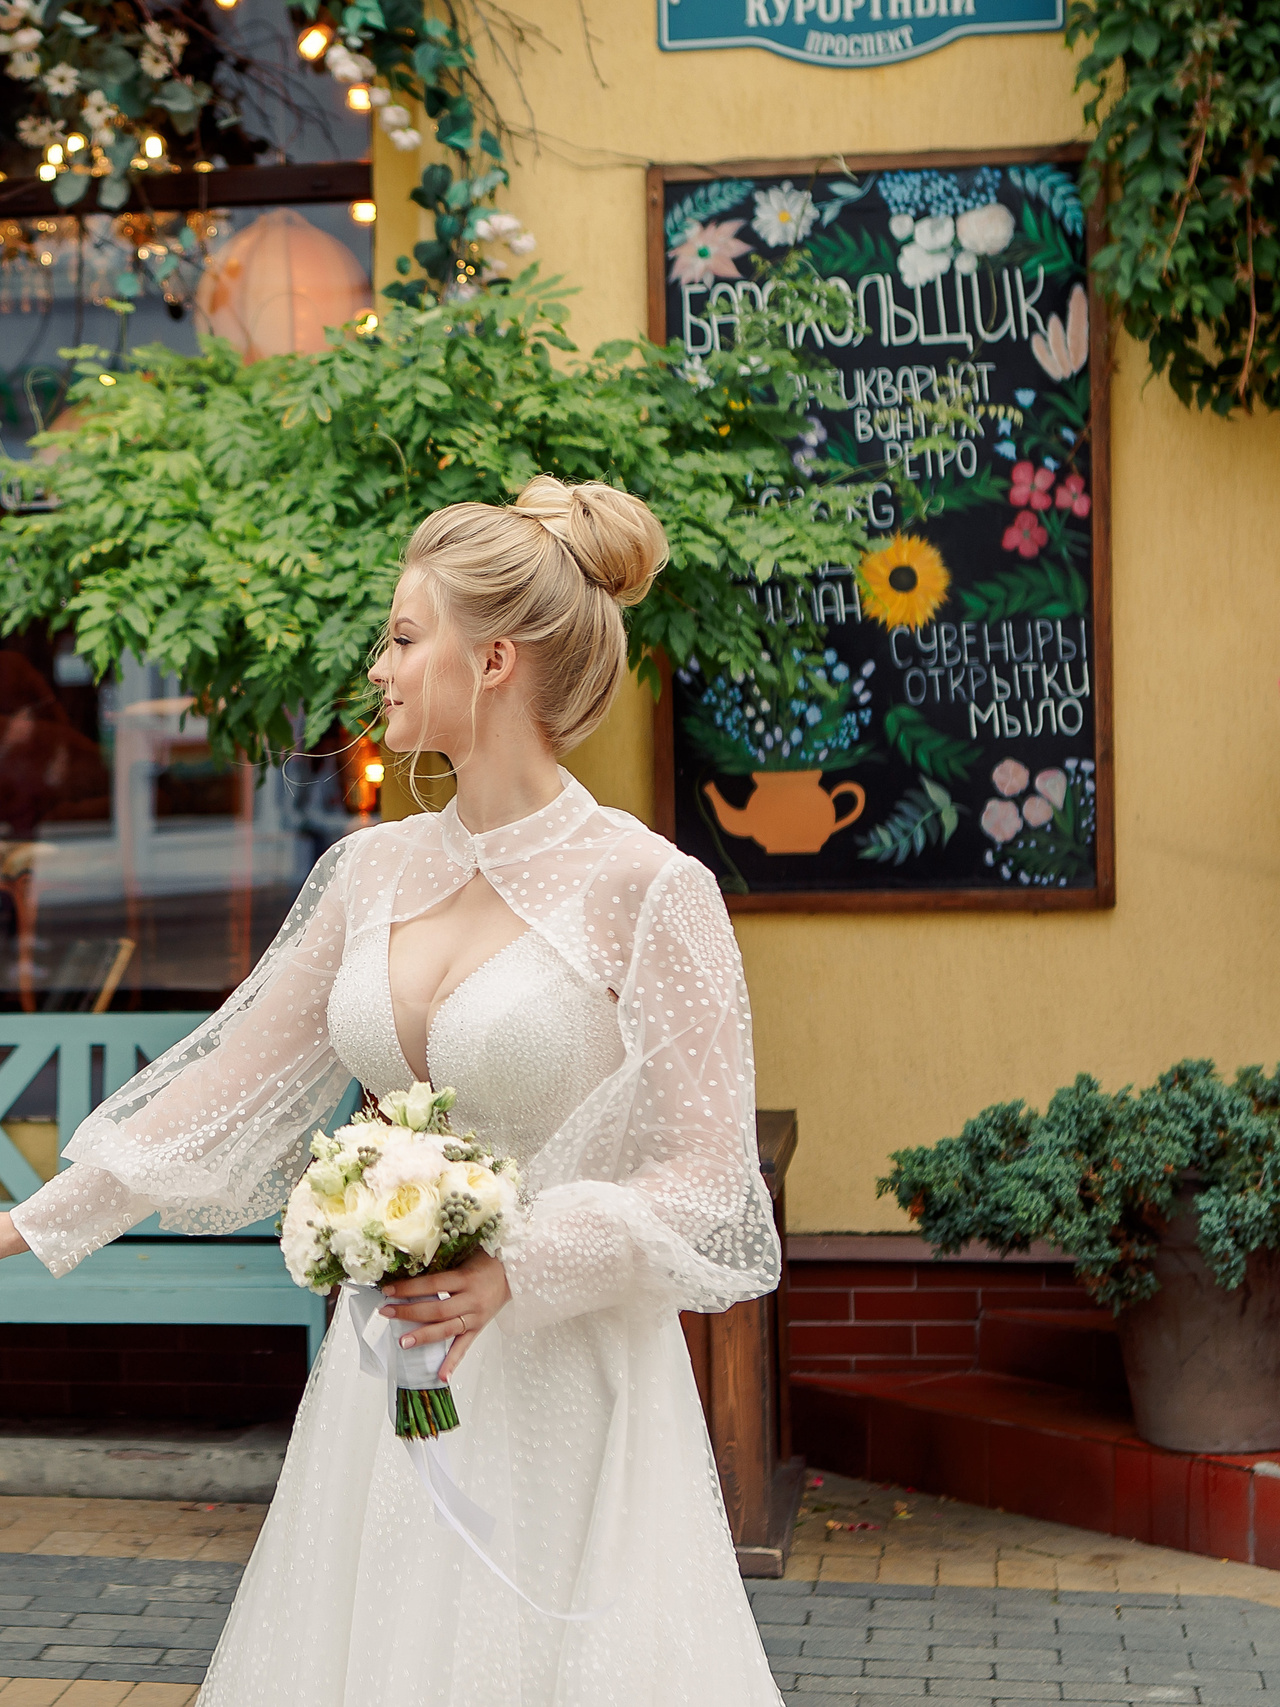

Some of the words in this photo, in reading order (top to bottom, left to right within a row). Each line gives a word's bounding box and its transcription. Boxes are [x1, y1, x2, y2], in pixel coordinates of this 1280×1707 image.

[804, 24, 914, 56] ПРОСПЕКТ
[682, 264, 1047, 354] БАРХОЛЬЩИК
[889, 617, 1088, 669] СУВЕНИРЫ
[904, 660, 1091, 705] ОТКРЫТКИ
[969, 697, 1084, 740] МЫЛО
